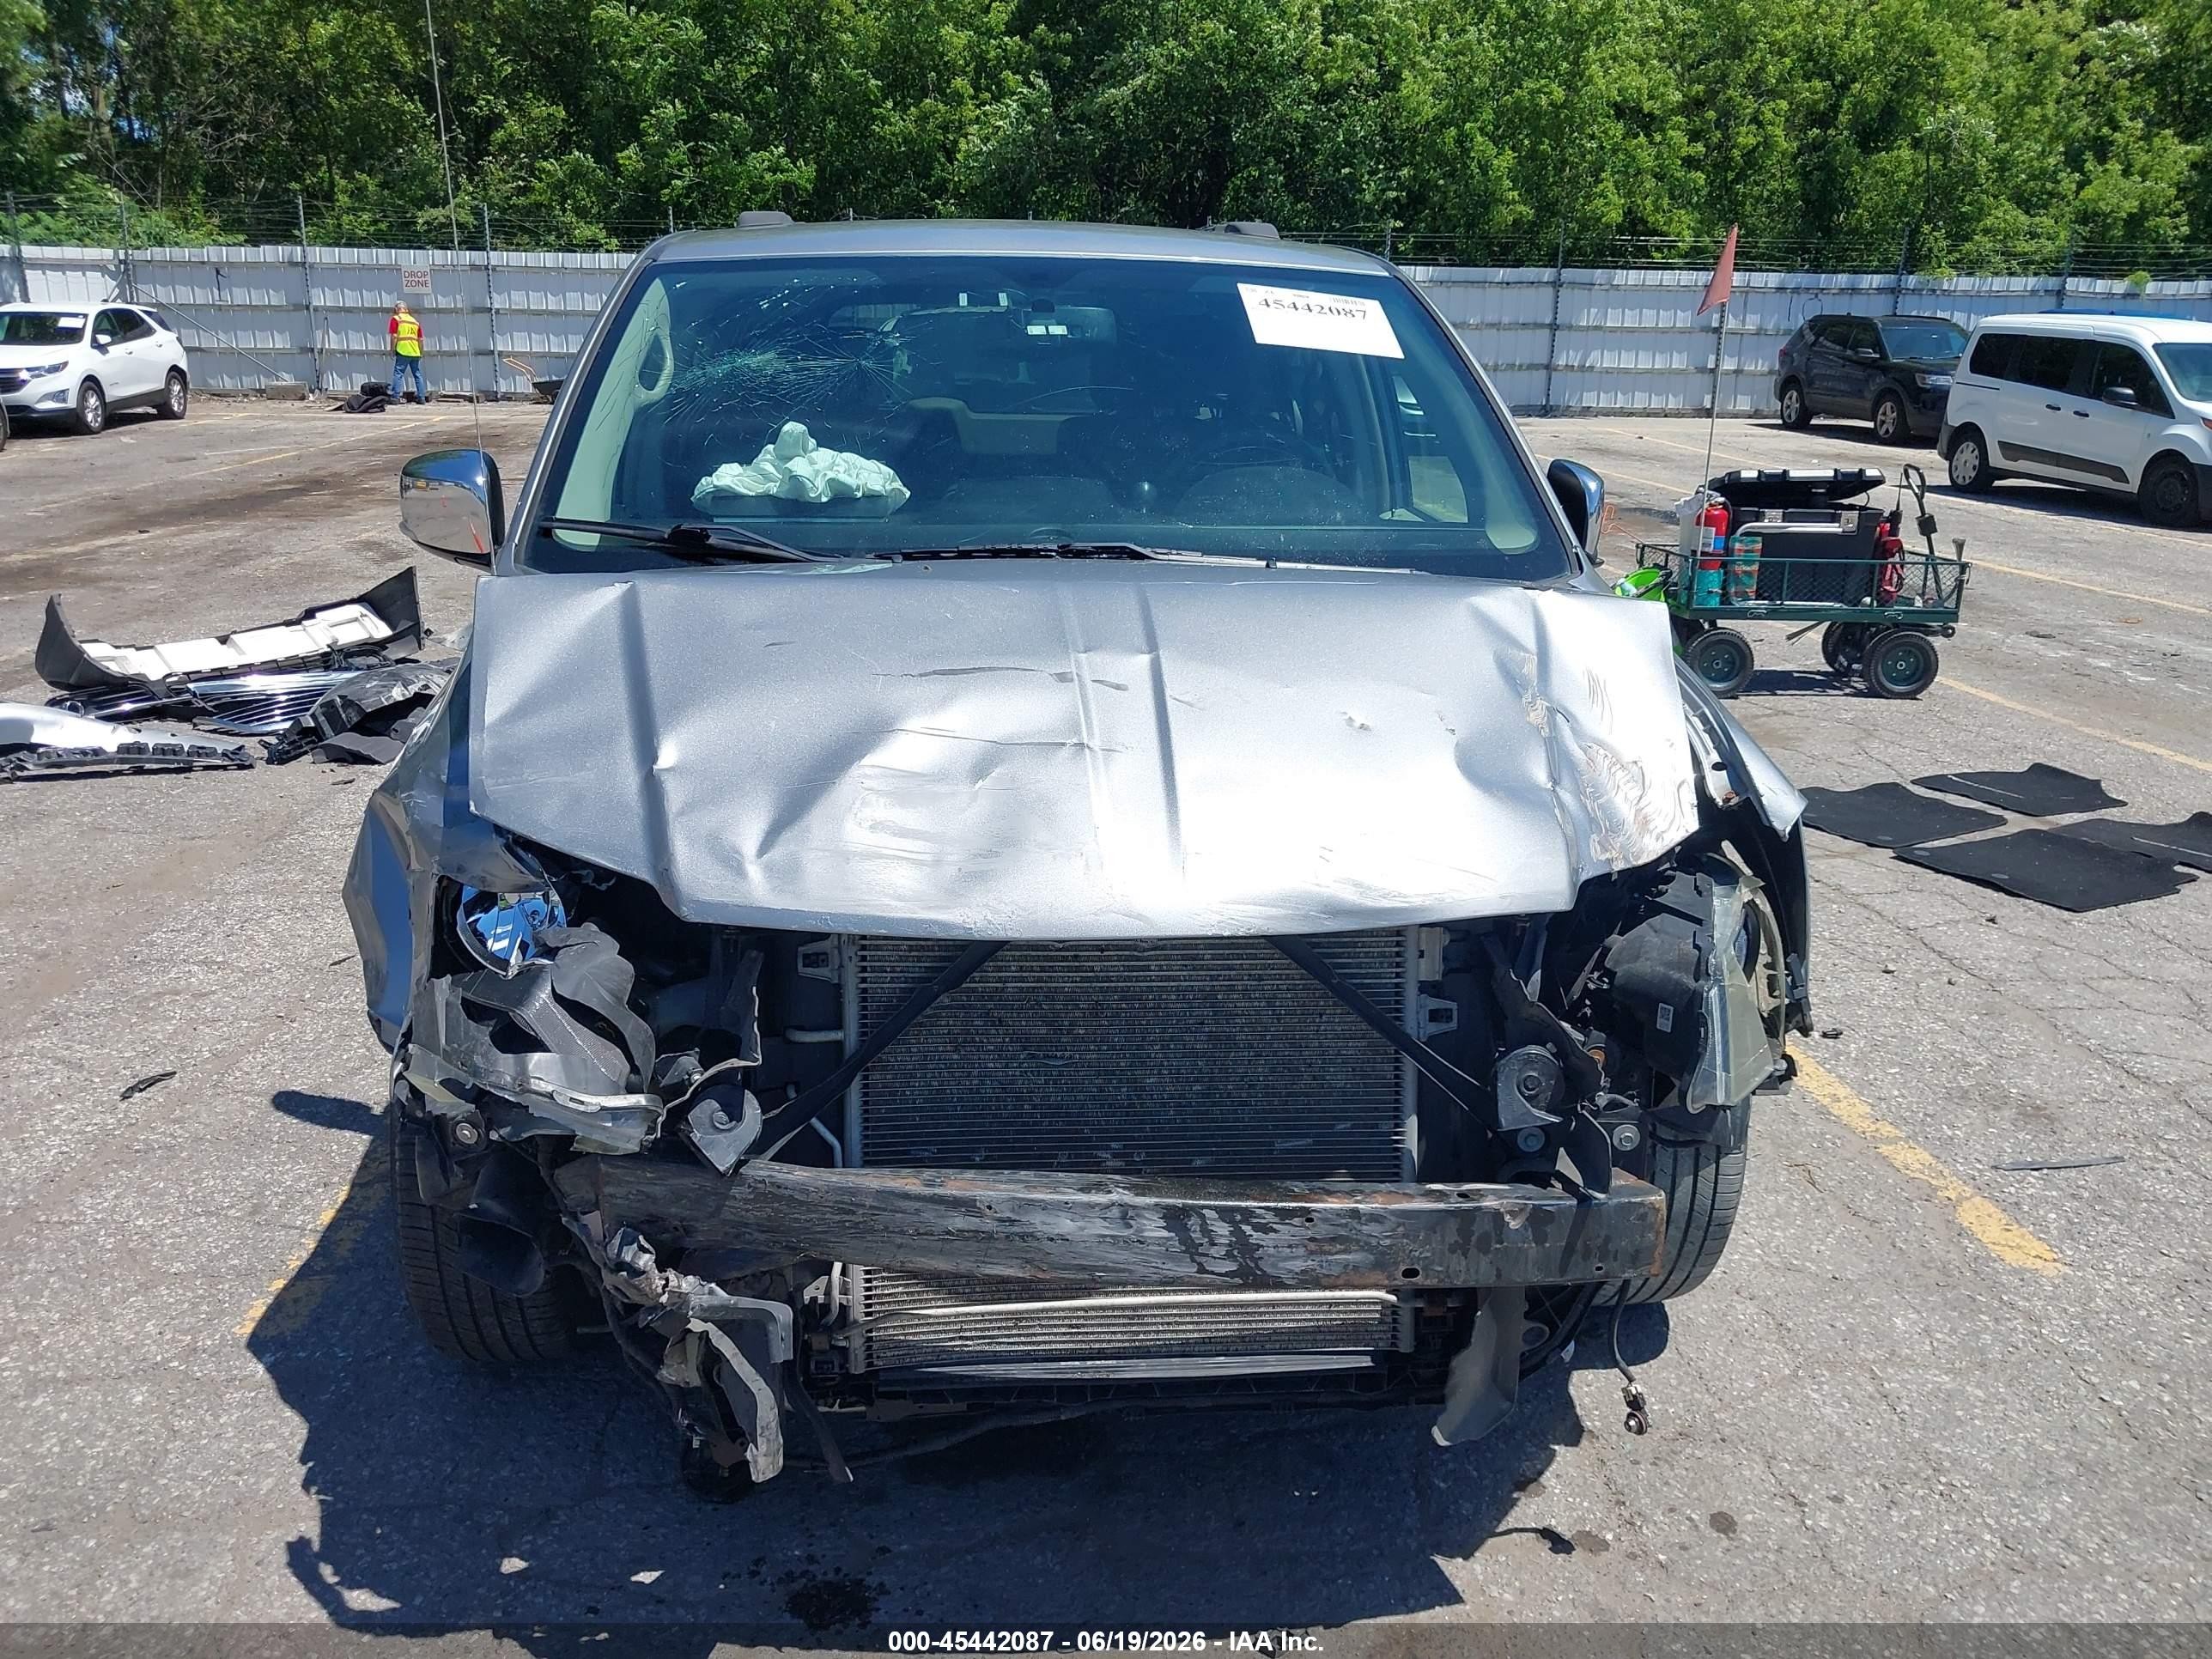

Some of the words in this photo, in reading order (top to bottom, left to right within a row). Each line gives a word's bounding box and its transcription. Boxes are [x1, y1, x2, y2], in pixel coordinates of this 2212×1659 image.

[404, 270, 428, 279] DROP
[404, 279, 430, 288] ZONE
[1258, 298, 1367, 320] 45442087
